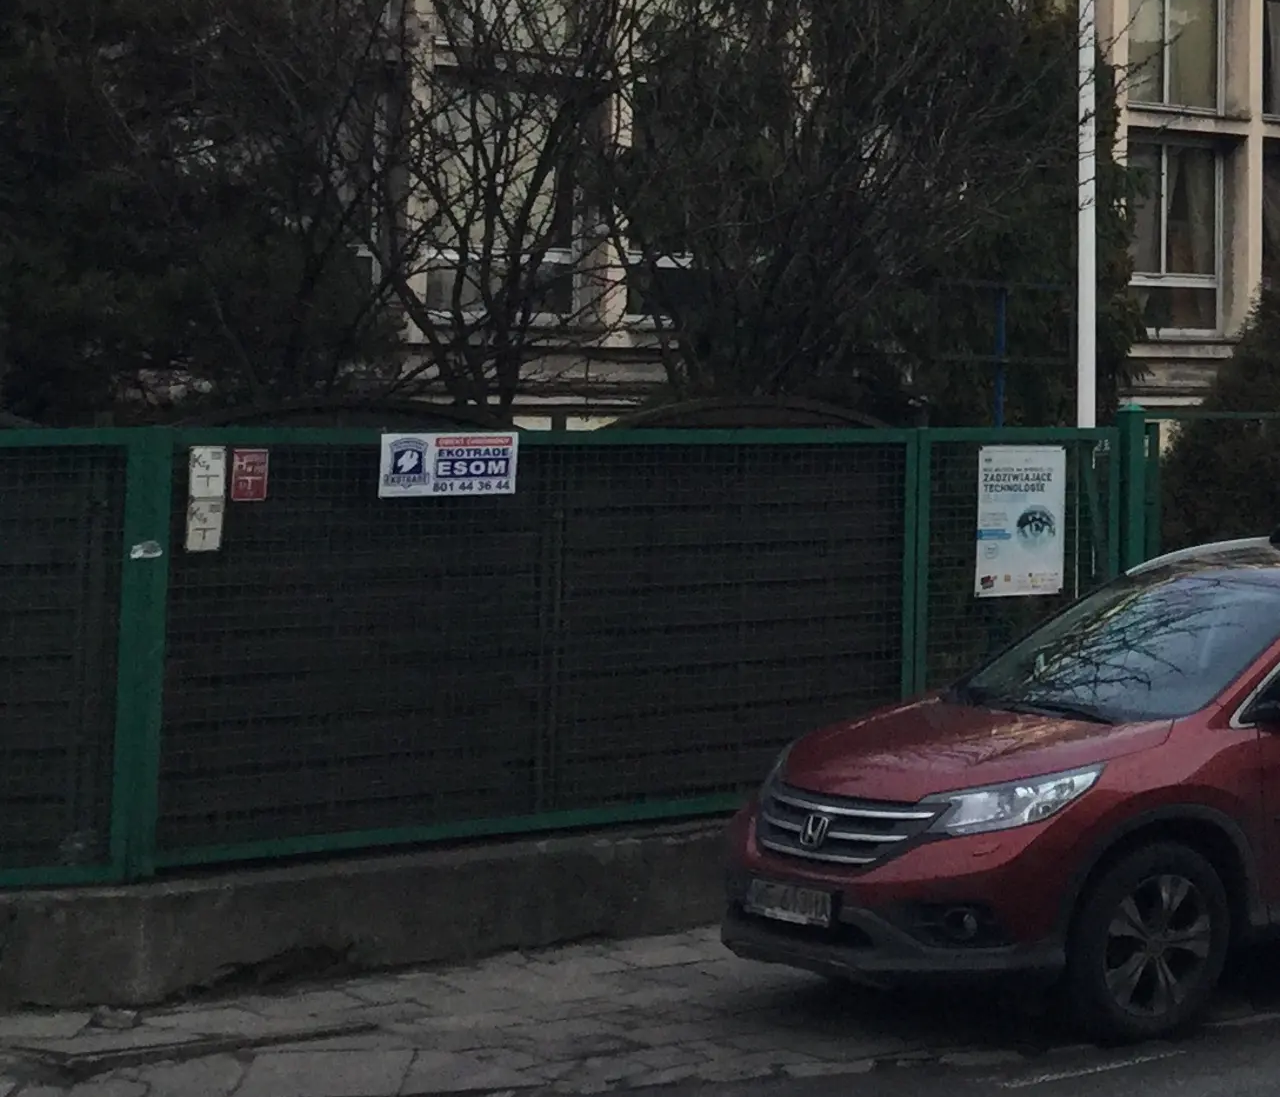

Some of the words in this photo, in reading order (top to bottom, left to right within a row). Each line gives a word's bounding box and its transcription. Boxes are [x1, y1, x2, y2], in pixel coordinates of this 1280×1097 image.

[438, 448, 508, 458] EKOTRADE
[437, 460, 507, 476] ESOM
[459, 482, 473, 492] 44
[478, 481, 492, 491] 36
[496, 480, 510, 490] 44
[984, 483, 1046, 493] TECHNOLOGIE
